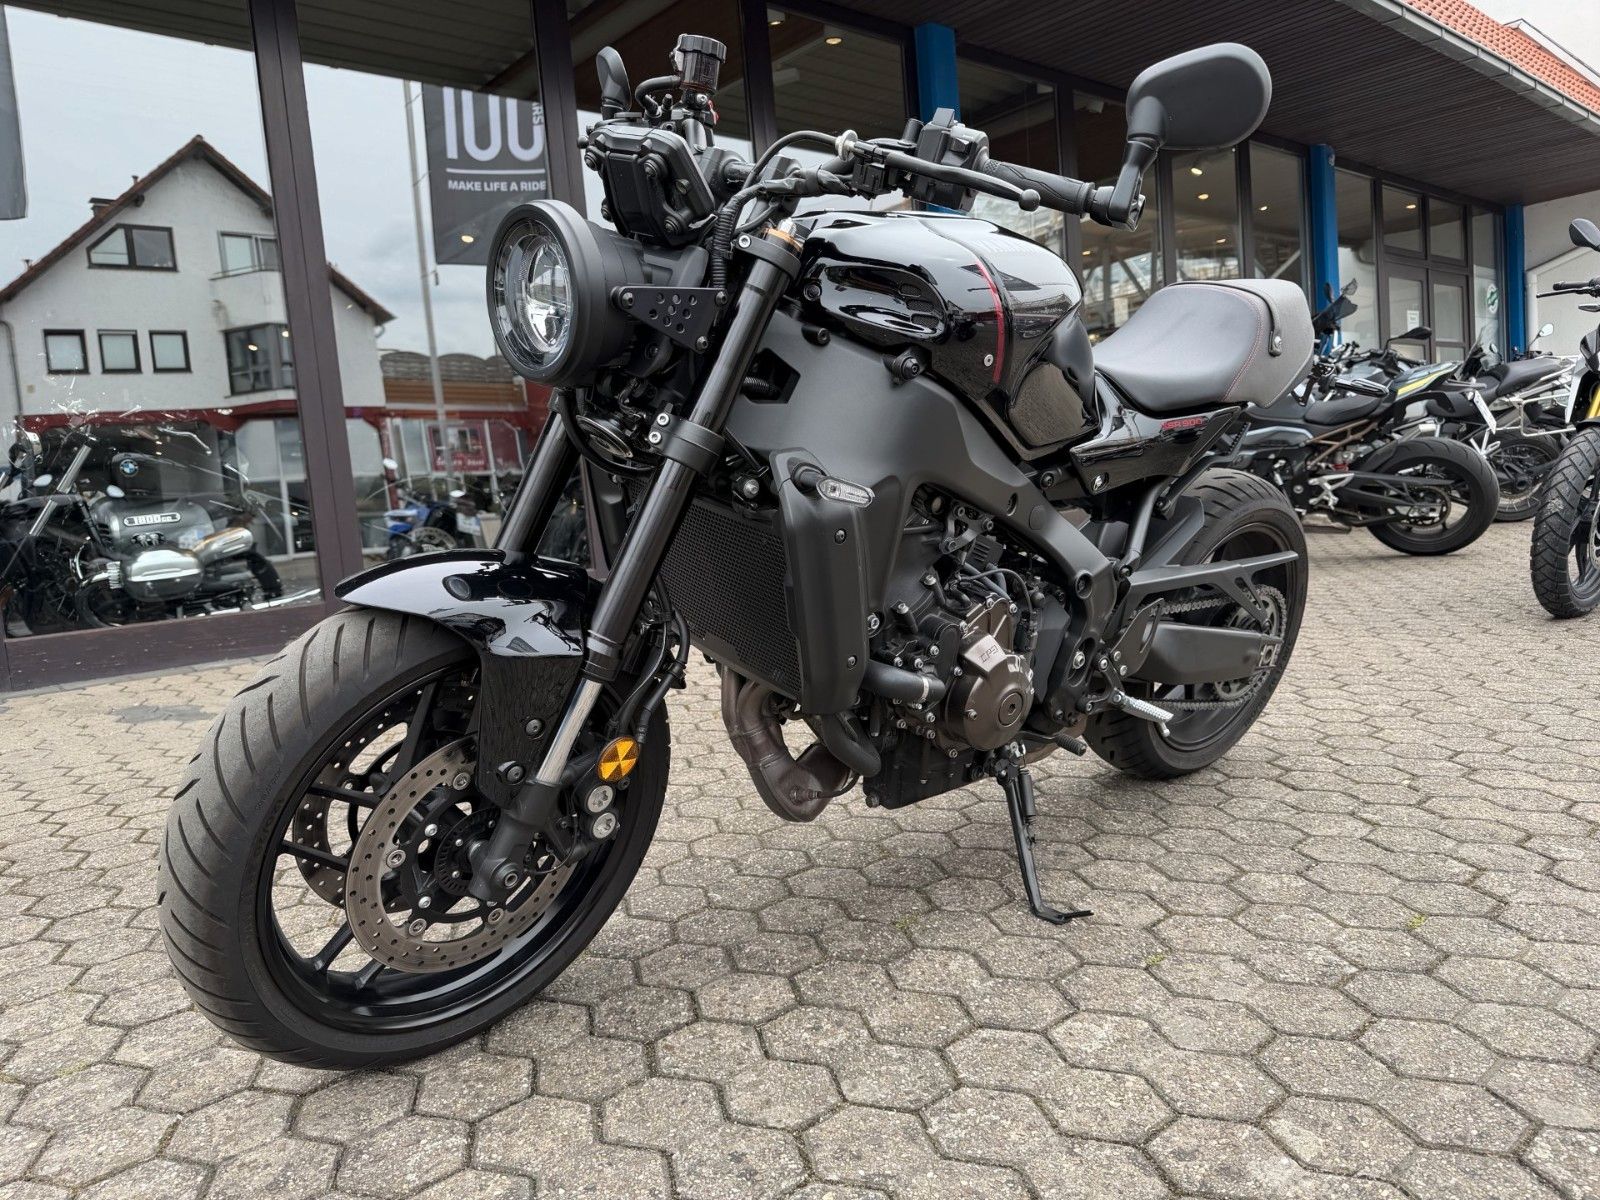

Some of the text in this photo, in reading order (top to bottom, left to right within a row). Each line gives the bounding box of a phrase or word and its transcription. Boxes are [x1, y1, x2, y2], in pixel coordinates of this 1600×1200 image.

[448, 180, 546, 191] MAKE LIFE A RIDE
